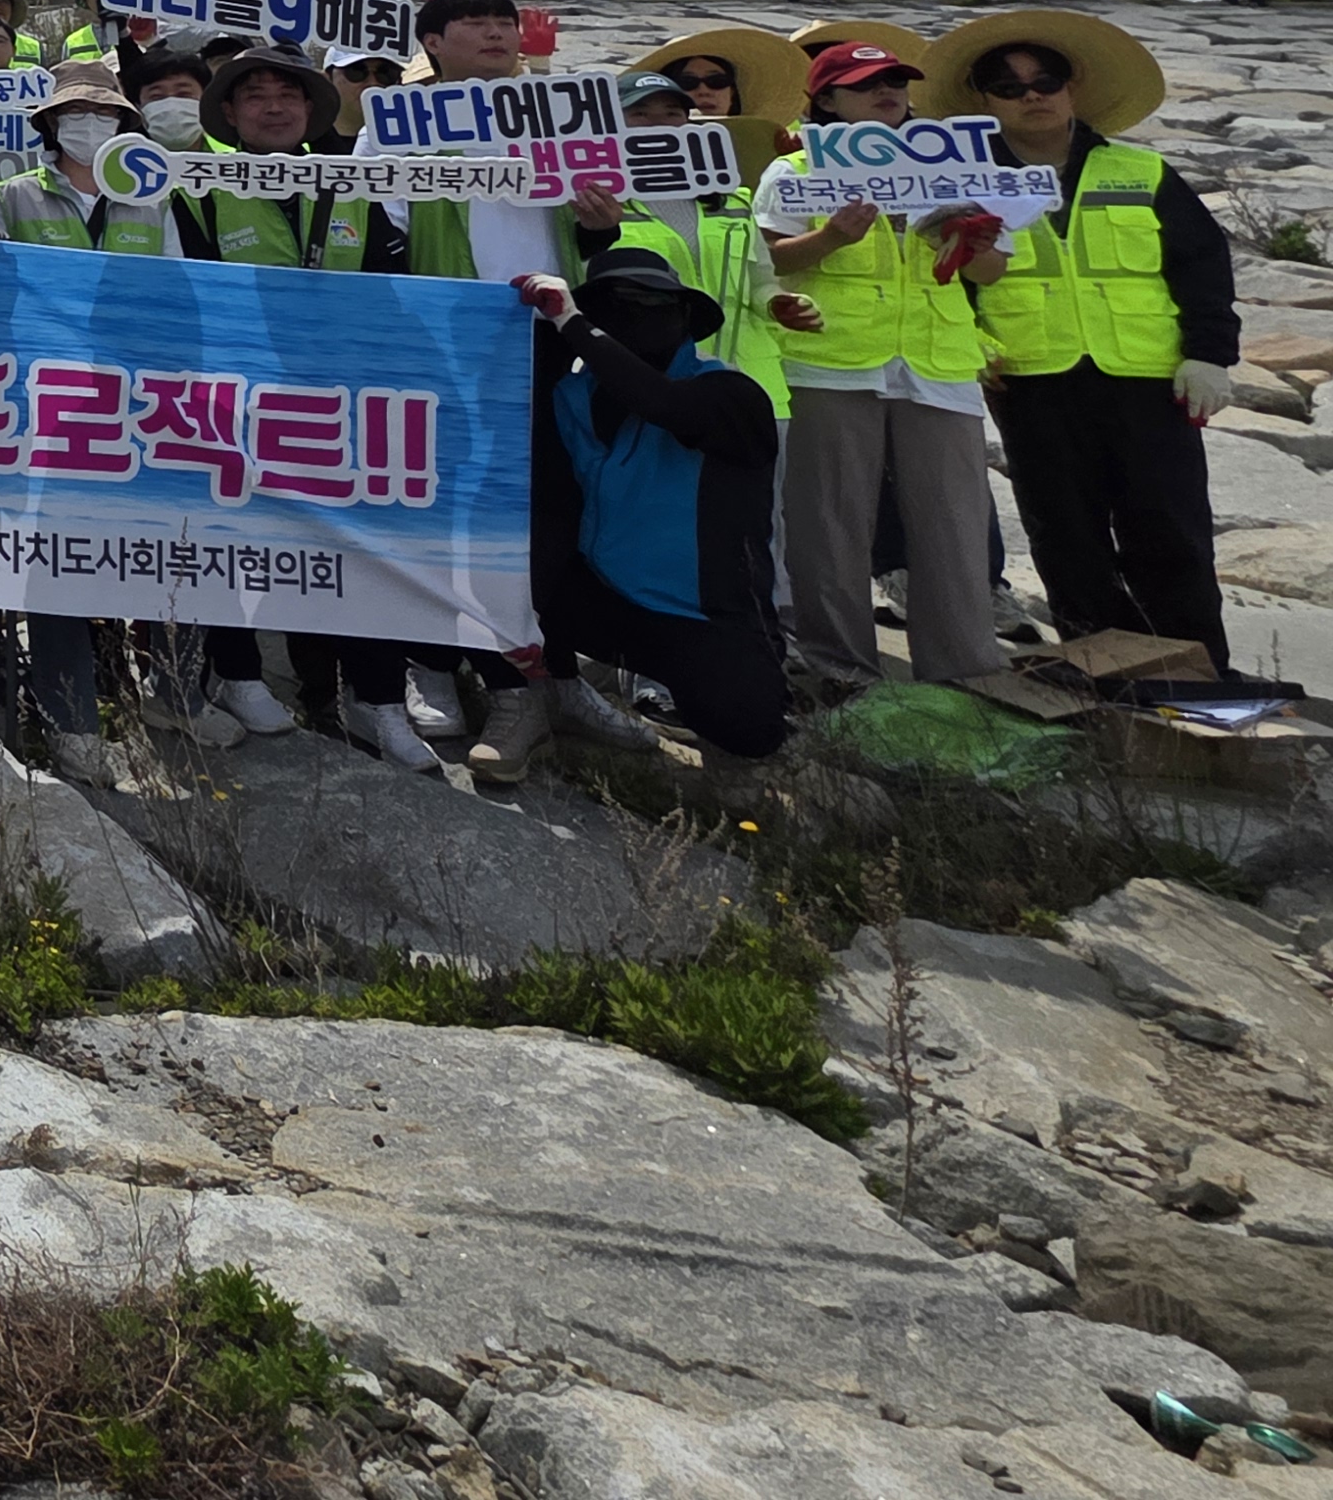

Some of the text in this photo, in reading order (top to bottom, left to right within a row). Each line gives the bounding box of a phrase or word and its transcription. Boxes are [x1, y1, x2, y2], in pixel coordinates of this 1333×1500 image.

[371, 78, 618, 146] 바다에게
[180, 160, 528, 194] 주택관리공단 전북지사
[776, 171, 1057, 204] 한국농업기술진흥원
